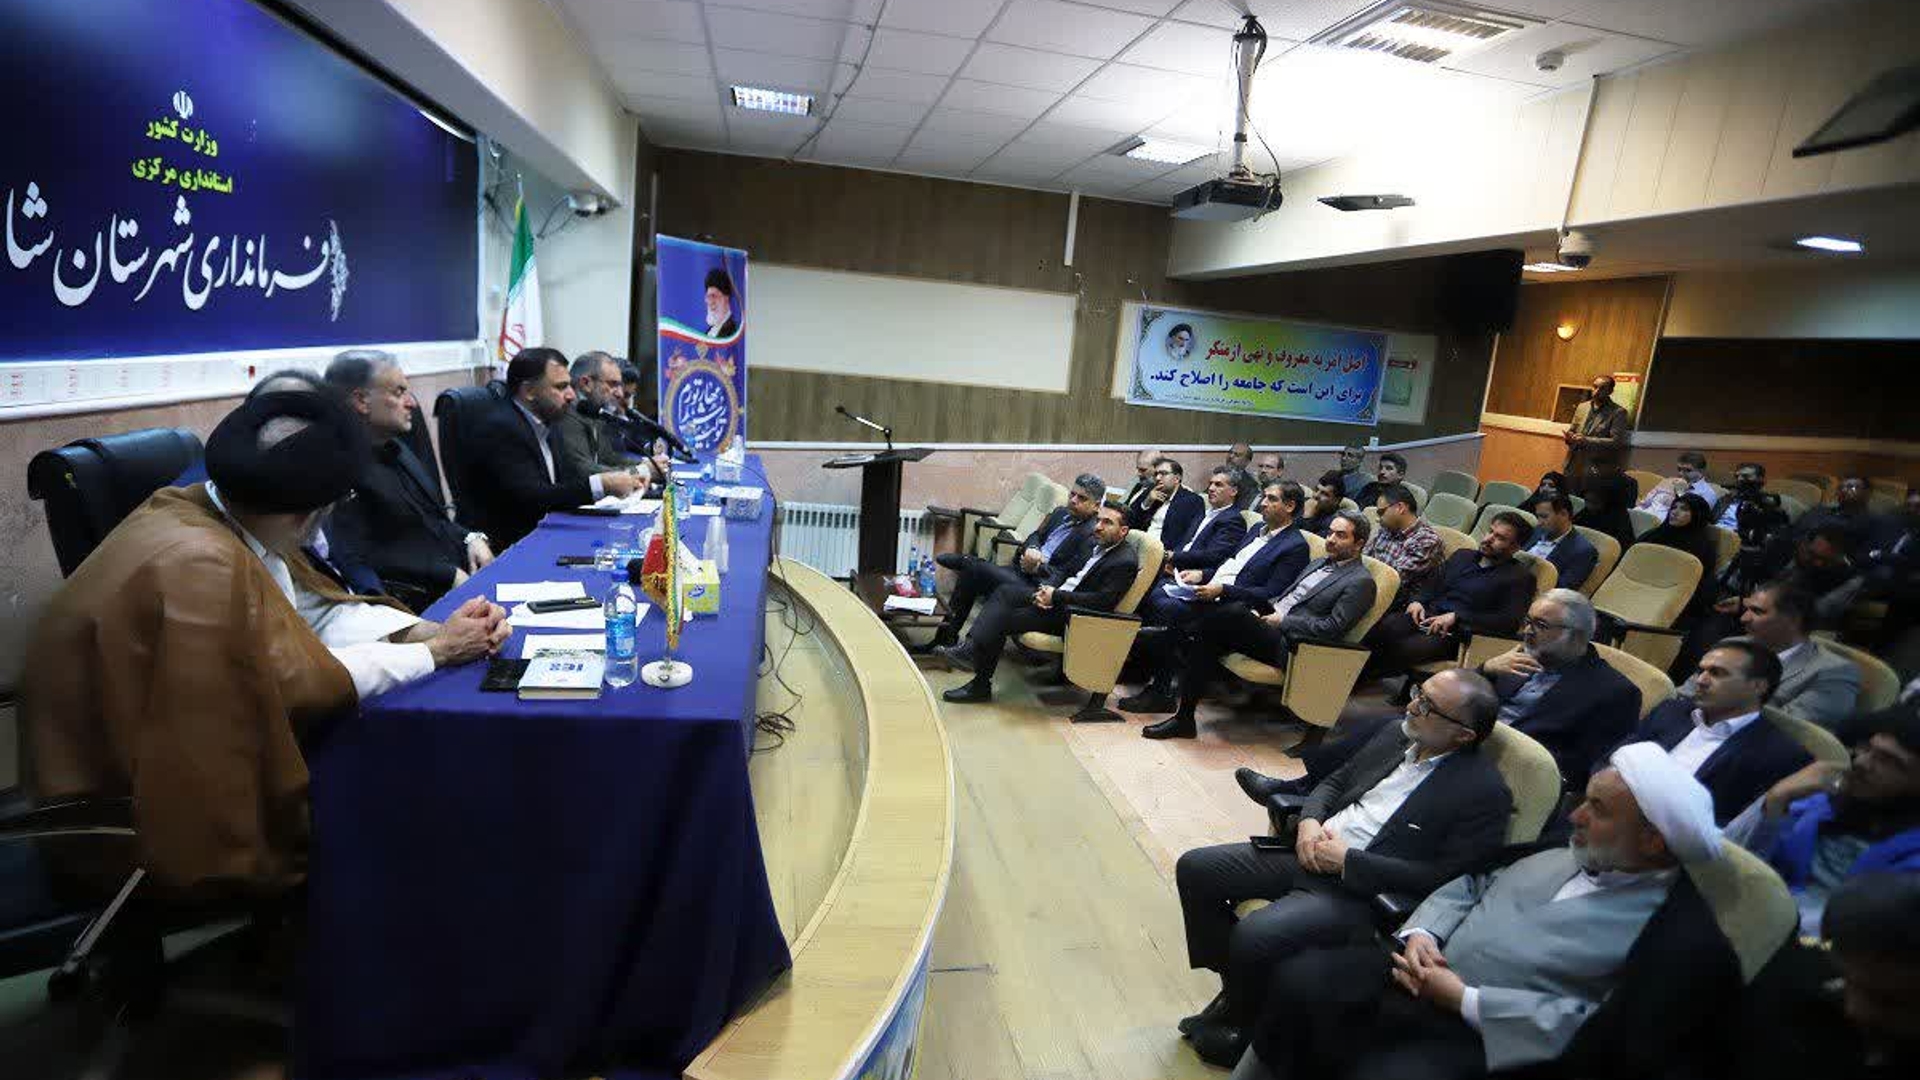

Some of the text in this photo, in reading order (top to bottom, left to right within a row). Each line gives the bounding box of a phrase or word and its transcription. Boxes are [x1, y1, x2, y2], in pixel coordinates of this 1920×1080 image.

[145, 116, 218, 157] وزارت کشور
[132, 157, 232, 193] استانداری مرکزی
[53, 194, 194, 306] شهرستان
[183, 234, 330, 311] فرمانداری
[1242, 344, 1264, 363] نهی
[1265, 352, 1273, 366] و
[1312, 354, 1323, 369] به
[1325, 356, 1342, 371] امر
[1342, 354, 1368, 373] اصل
[1180, 370, 1216, 387] اصلاح
[1219, 374, 1229, 391] را
[1233, 377, 1267, 394] جامعه
[1270, 380, 1285, 391] که
[1287, 382, 1313, 394] است
[1315, 385, 1334, 399] این
[1336, 387, 1362, 403] برای
